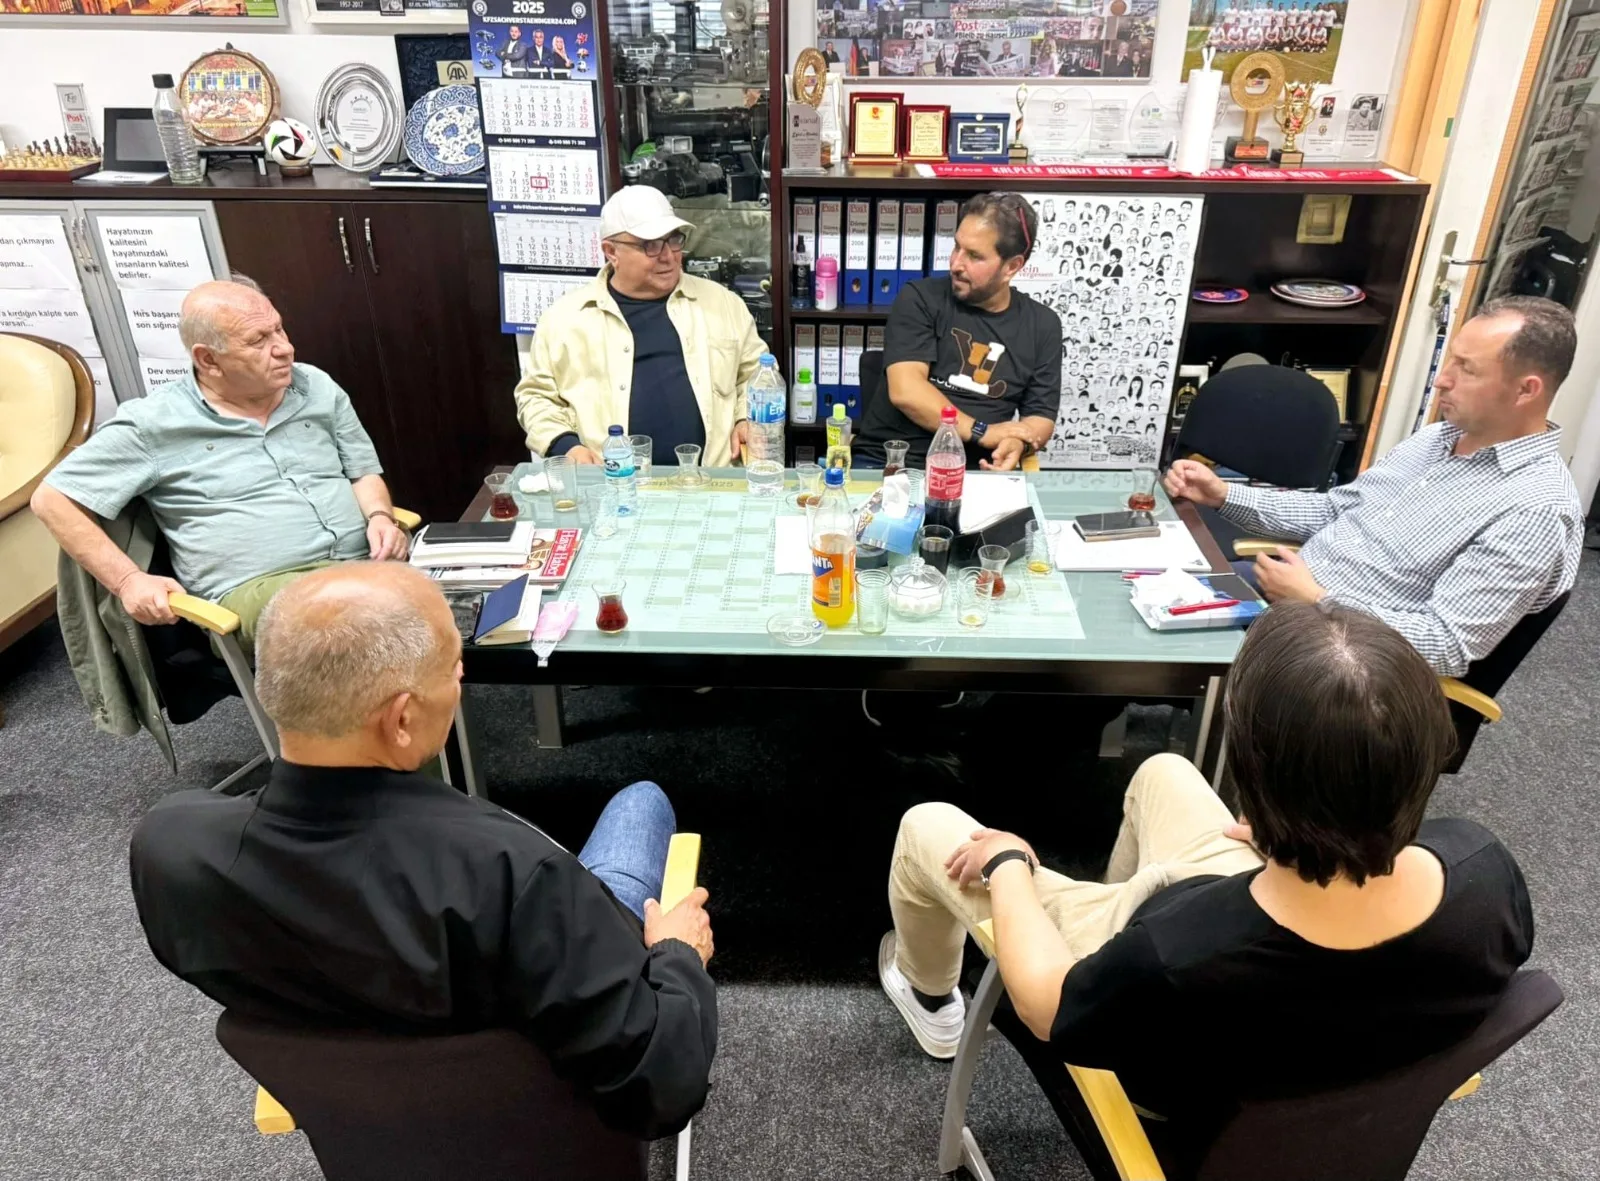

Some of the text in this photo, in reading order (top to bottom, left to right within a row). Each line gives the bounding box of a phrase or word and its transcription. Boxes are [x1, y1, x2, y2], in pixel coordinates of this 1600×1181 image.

[512, 1, 545, 14] 2025
[955, 20, 978, 30] Post
[797, 206, 813, 215] Post
[822, 203, 839, 212] Post
[850, 204, 867, 213] Post
[881, 205, 897, 214] Post
[905, 205, 922, 214] Post
[938, 206, 956, 214] Post
[106, 228, 153, 237] Hayatınızın
[17, 238, 54, 246] çıkmayan
[112, 249, 168, 258] hayatınızdaki
[38, 310, 62, 318] kalpte
[548, 530, 576, 575] Hayat Haber
